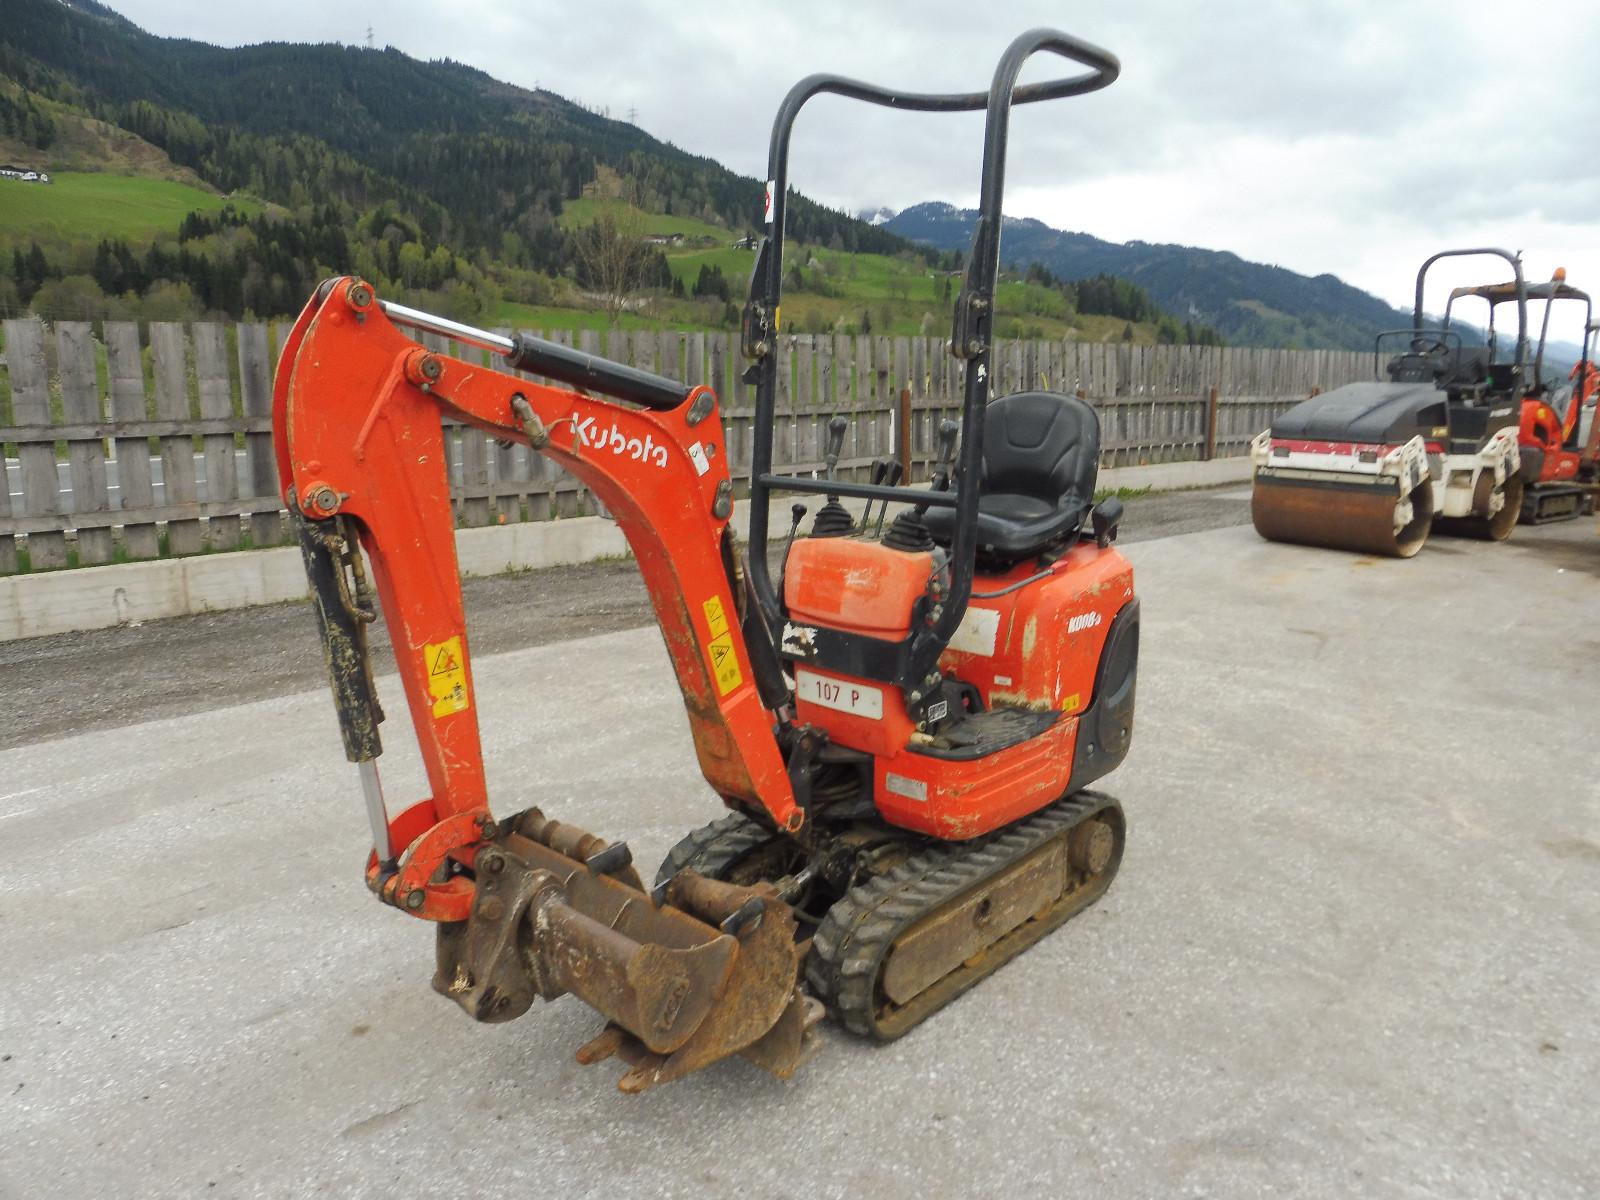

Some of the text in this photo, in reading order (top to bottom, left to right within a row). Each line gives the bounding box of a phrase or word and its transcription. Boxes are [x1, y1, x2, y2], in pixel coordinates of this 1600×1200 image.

[570, 412, 668, 468] Kubota
[816, 680, 860, 707] 107 P
